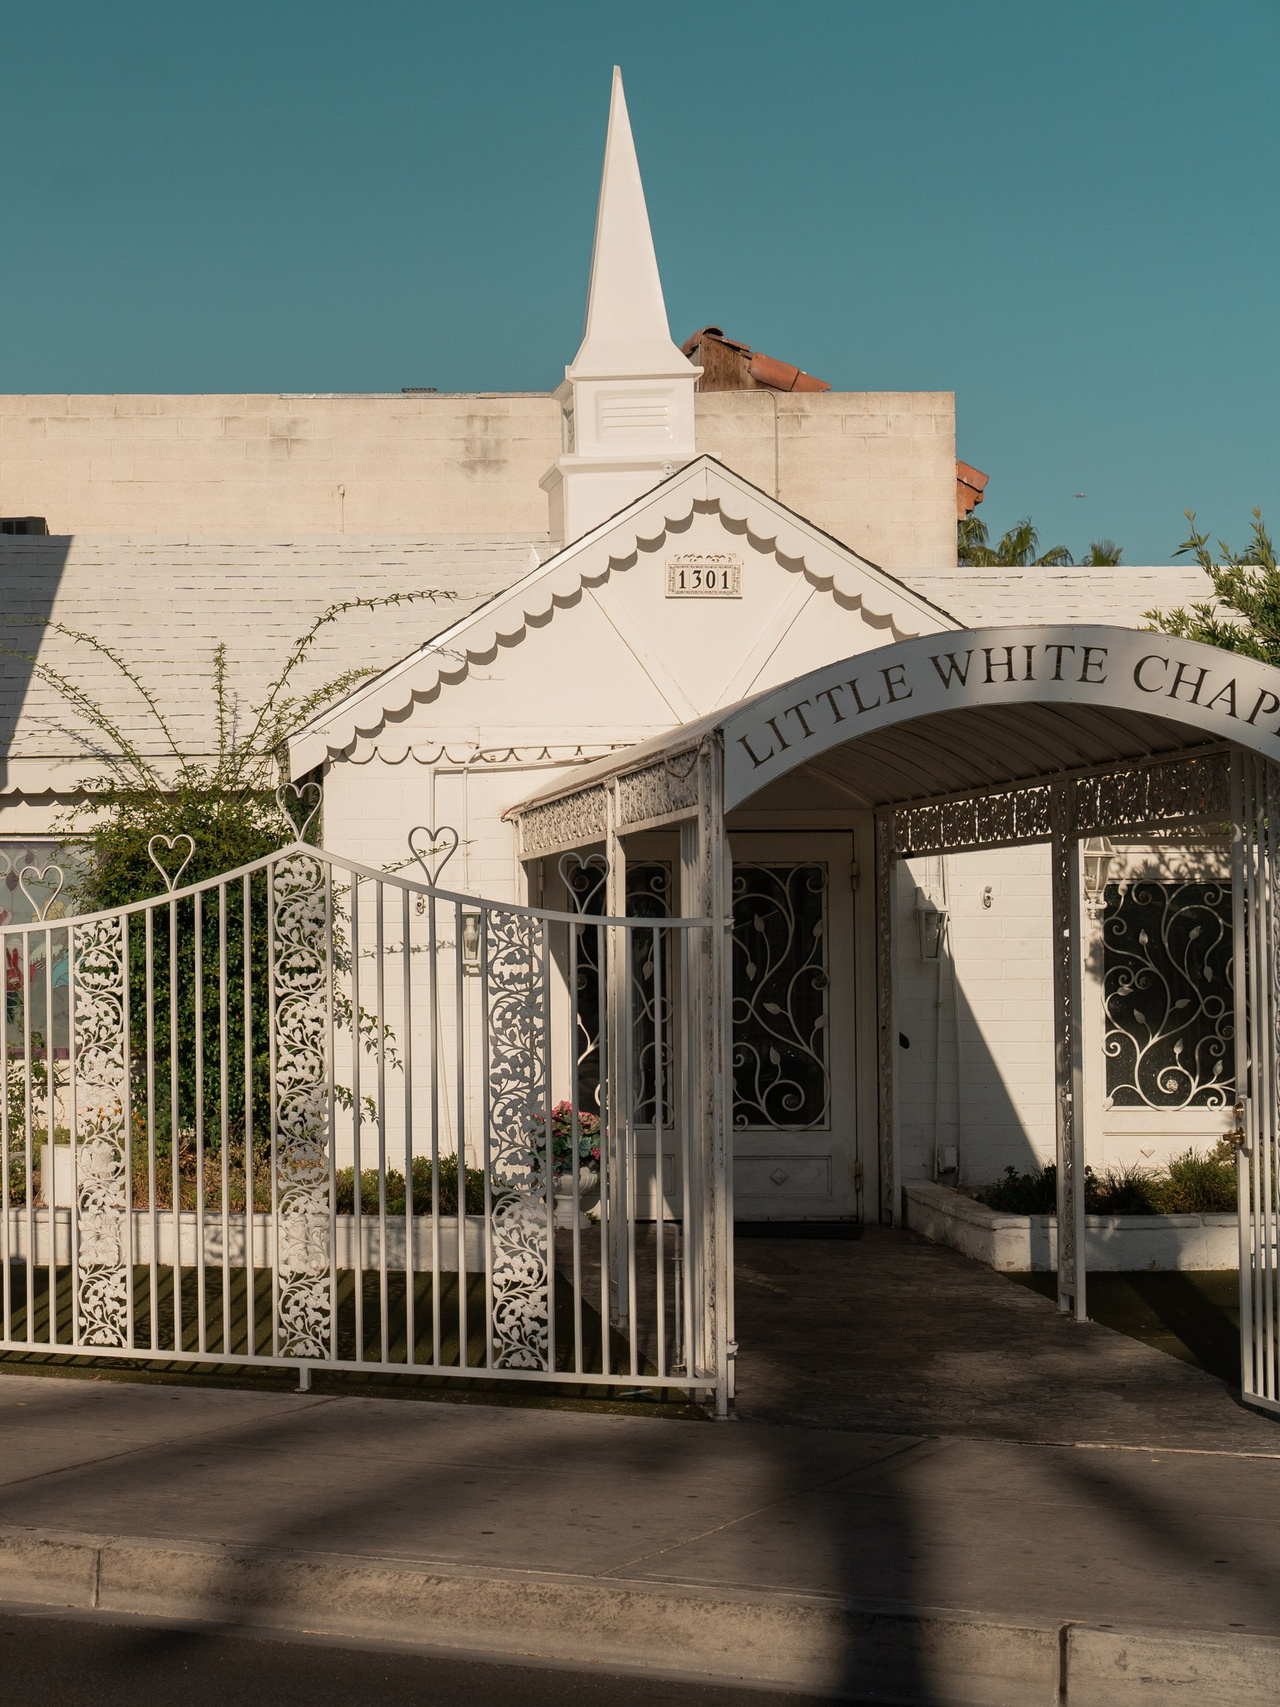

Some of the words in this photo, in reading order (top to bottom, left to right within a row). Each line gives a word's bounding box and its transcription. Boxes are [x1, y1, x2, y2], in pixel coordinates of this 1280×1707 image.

[678, 570, 729, 589] 1301
[735, 662, 914, 771] LITTLE
[927, 643, 1109, 691] WHITE
[1132, 653, 1280, 739] CHAP
